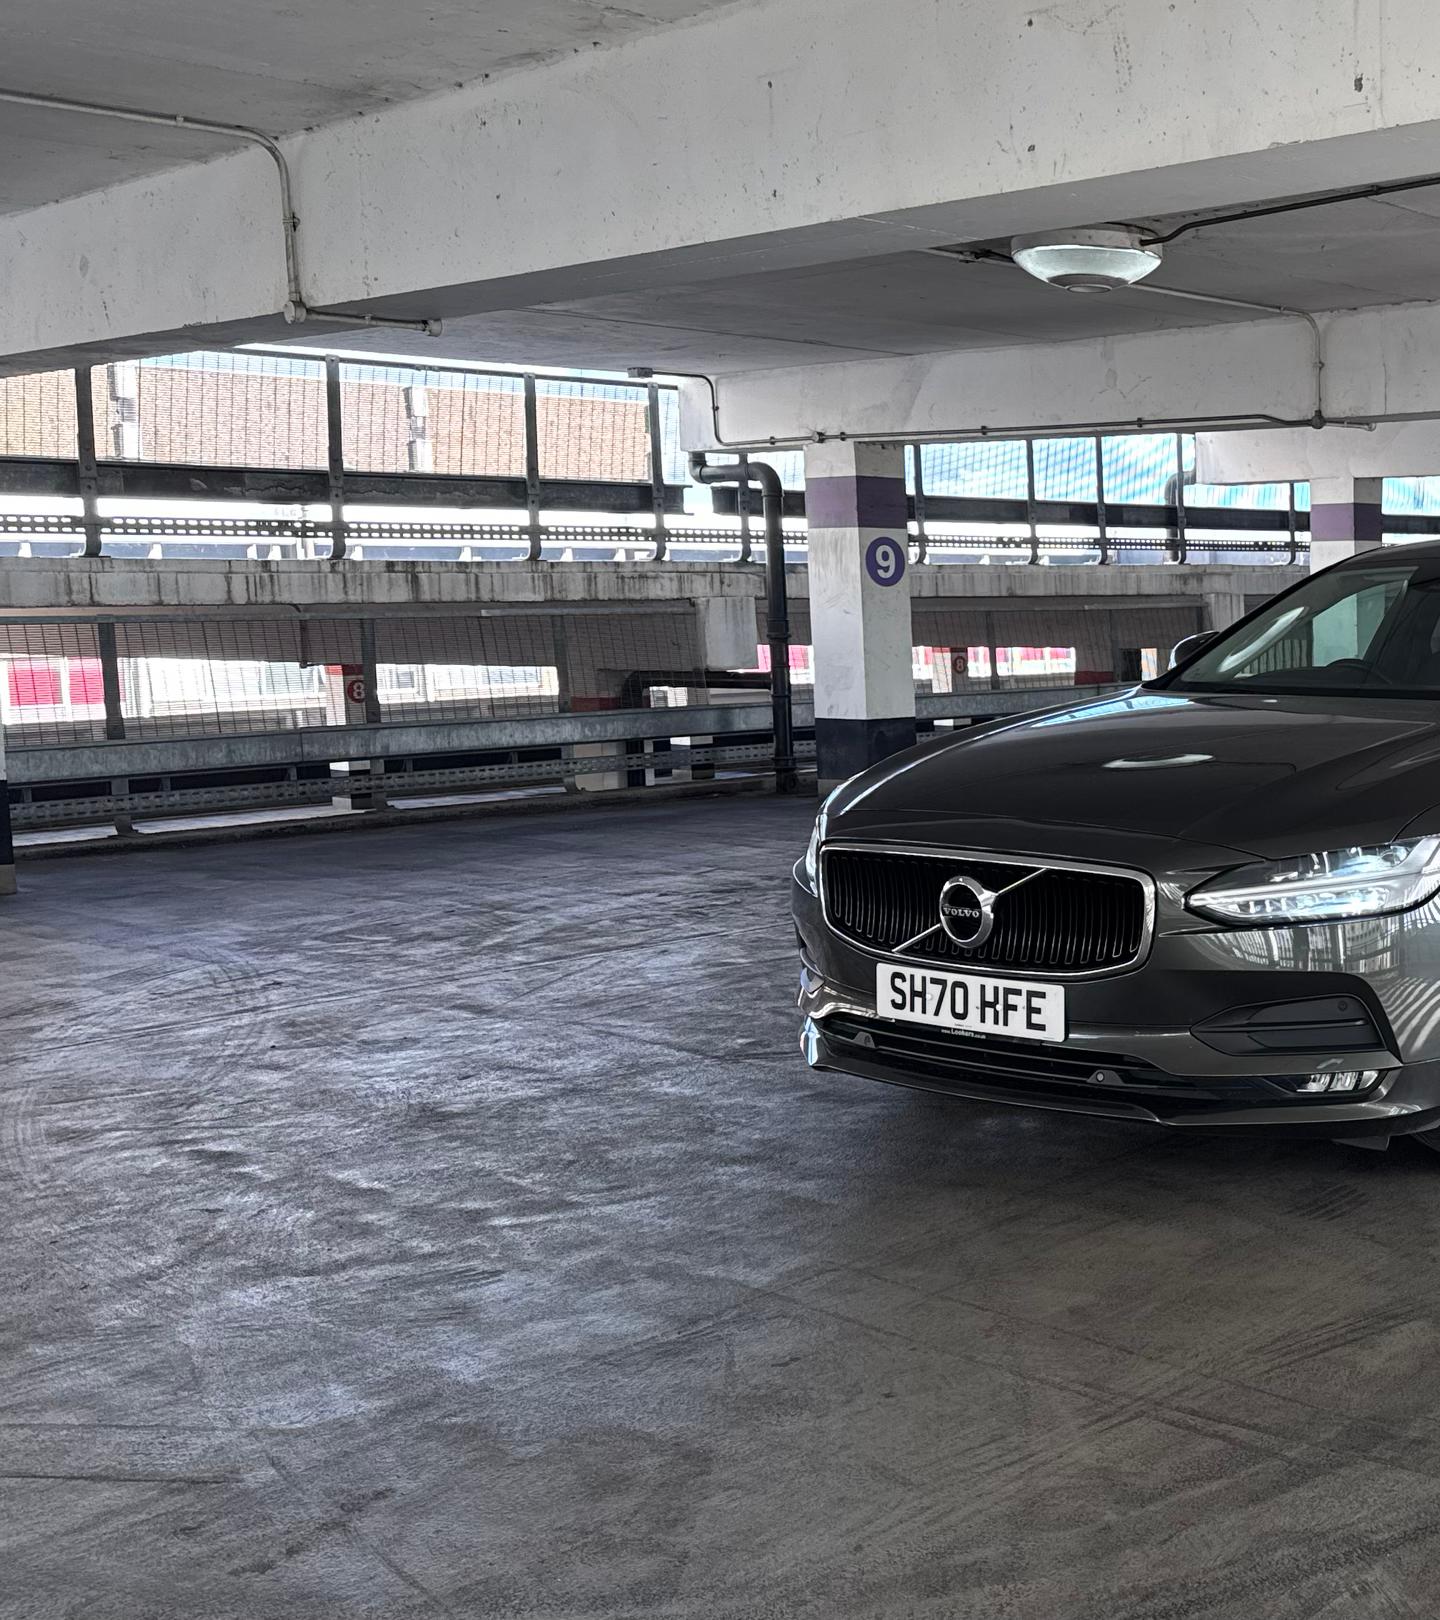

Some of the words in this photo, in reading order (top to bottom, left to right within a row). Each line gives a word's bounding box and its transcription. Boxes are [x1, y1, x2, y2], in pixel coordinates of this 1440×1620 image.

[875, 544, 896, 579] 9
[956, 658, 964, 671] 8
[353, 682, 365, 699] 8
[943, 907, 980, 918] VOLVO
[890, 971, 969, 1021] SH70
[979, 983, 1047, 1032] HFE
